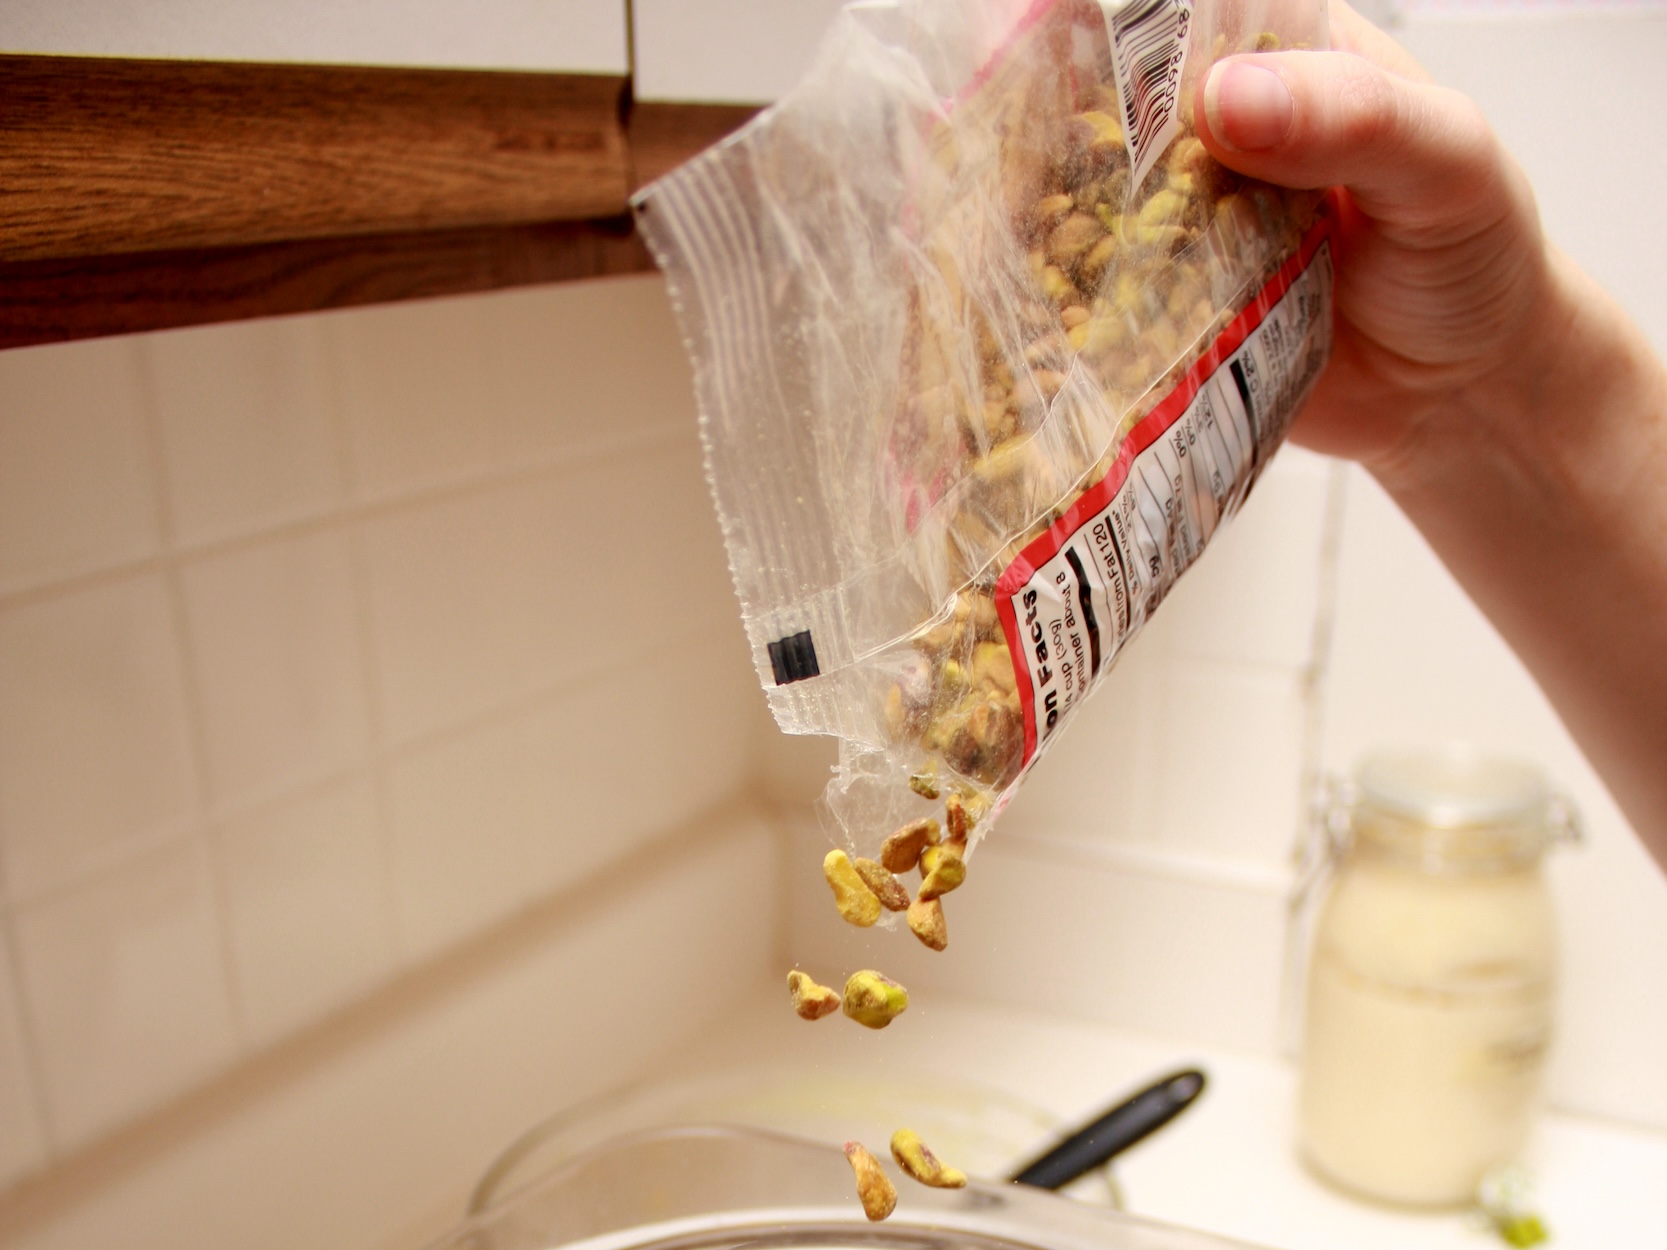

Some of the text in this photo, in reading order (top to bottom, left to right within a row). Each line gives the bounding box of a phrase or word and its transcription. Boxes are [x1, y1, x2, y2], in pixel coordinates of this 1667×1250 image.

[1092, 523, 1110, 553] 120
[1055, 571, 1066, 585] 8
[1103, 551, 1119, 580] Fat
[1061, 583, 1076, 629] about
[1023, 589, 1053, 688] Facts
[1049, 618, 1067, 660] (30g)
[1061, 662, 1073, 691] cup
